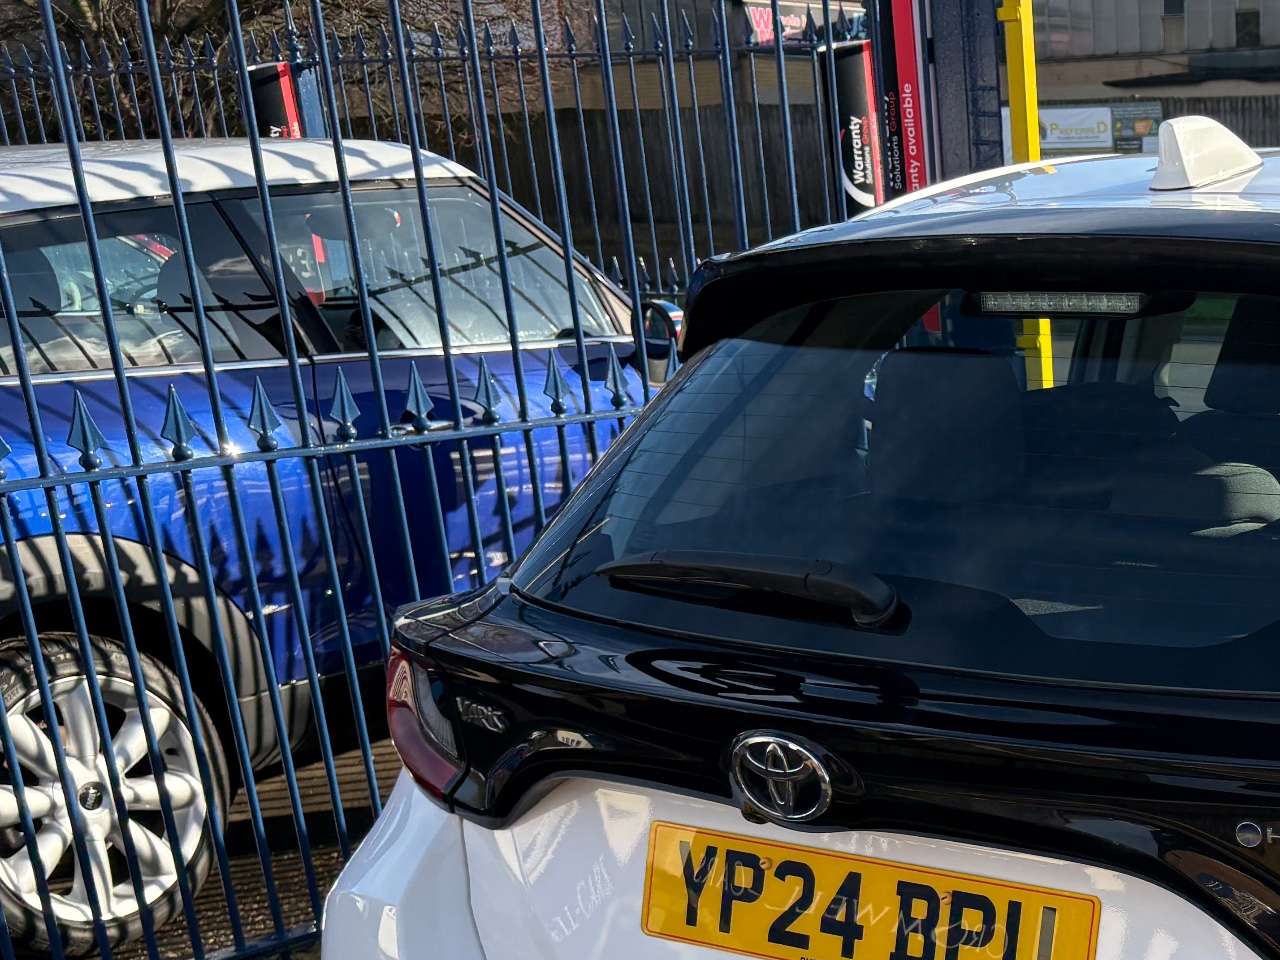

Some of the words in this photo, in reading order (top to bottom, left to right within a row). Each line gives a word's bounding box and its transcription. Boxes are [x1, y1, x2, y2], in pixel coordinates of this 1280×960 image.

[849, 115, 866, 185] Warranty
[902, 82, 918, 156] available
[892, 135, 902, 190] Solutions
[678, 840, 865, 960] YP24
